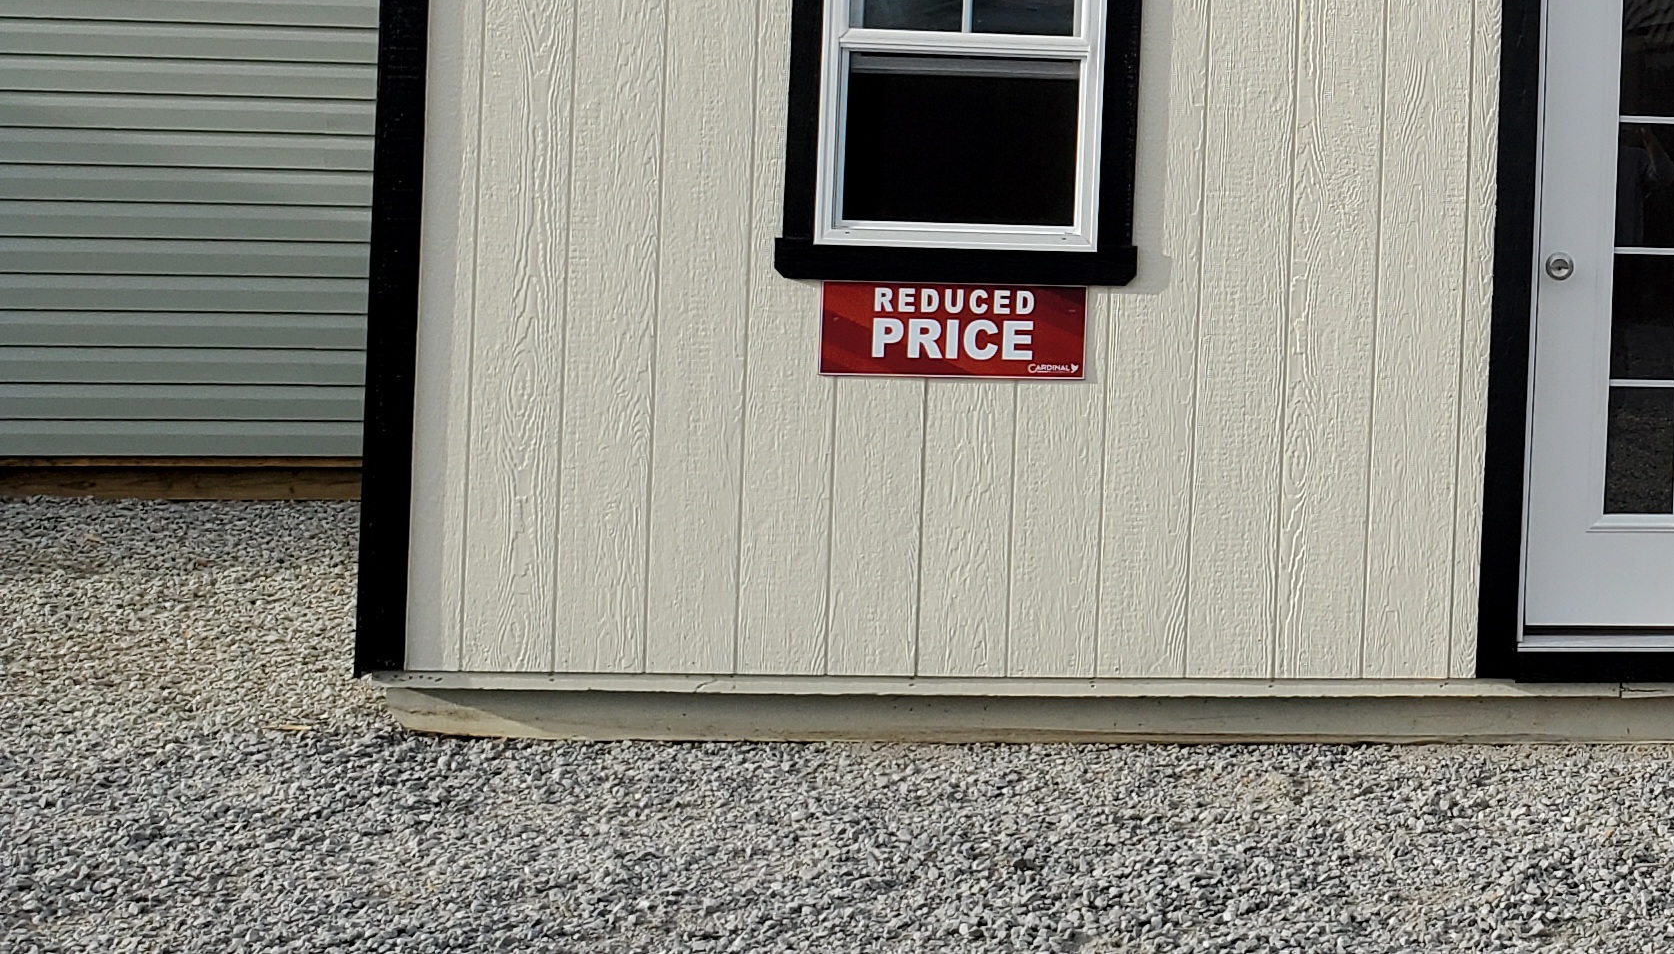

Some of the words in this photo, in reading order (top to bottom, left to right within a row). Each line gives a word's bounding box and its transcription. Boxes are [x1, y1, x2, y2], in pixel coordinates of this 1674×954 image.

[873, 287, 1035, 315] REDUCED
[871, 317, 1034, 361] PRICE
[1027, 363, 1071, 374] CARDINAL
